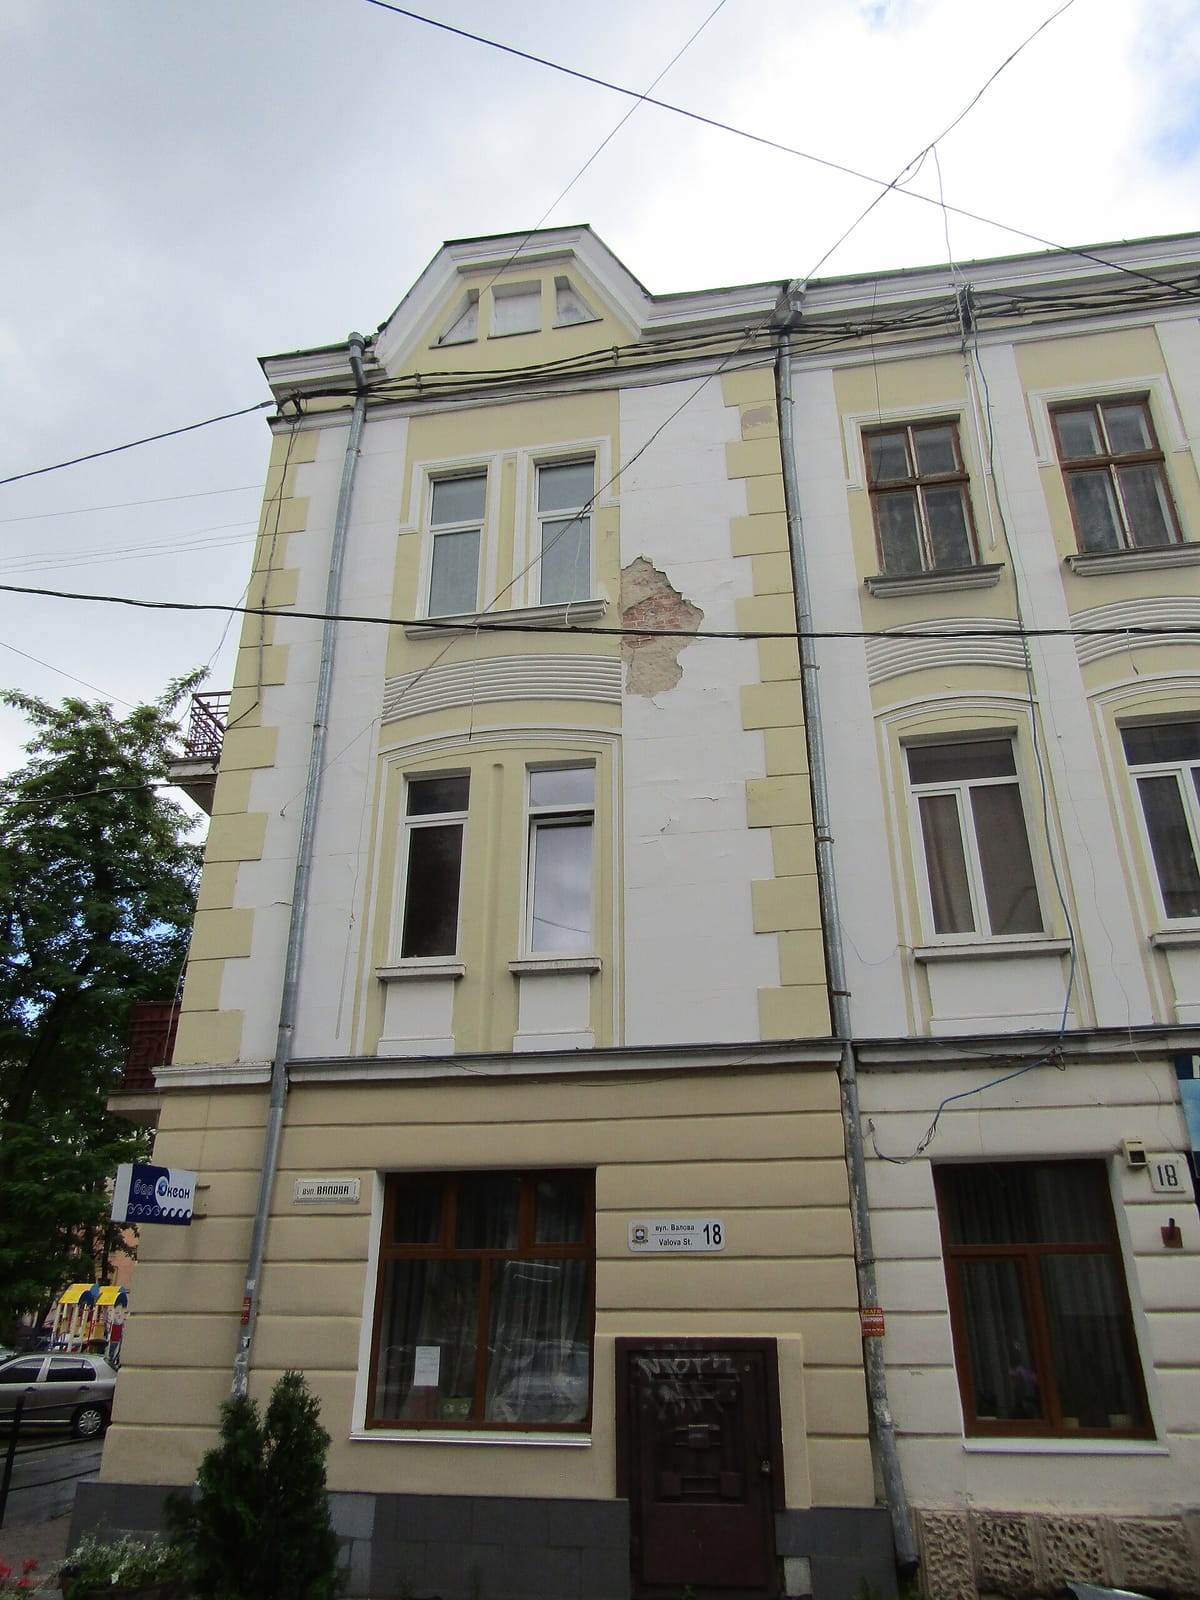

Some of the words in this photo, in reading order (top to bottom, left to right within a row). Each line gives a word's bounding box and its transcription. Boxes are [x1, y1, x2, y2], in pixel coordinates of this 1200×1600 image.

[1157, 1164, 1178, 1186] 18
[682, 1238, 693, 1246] St.
[703, 1224, 722, 1245] 18
